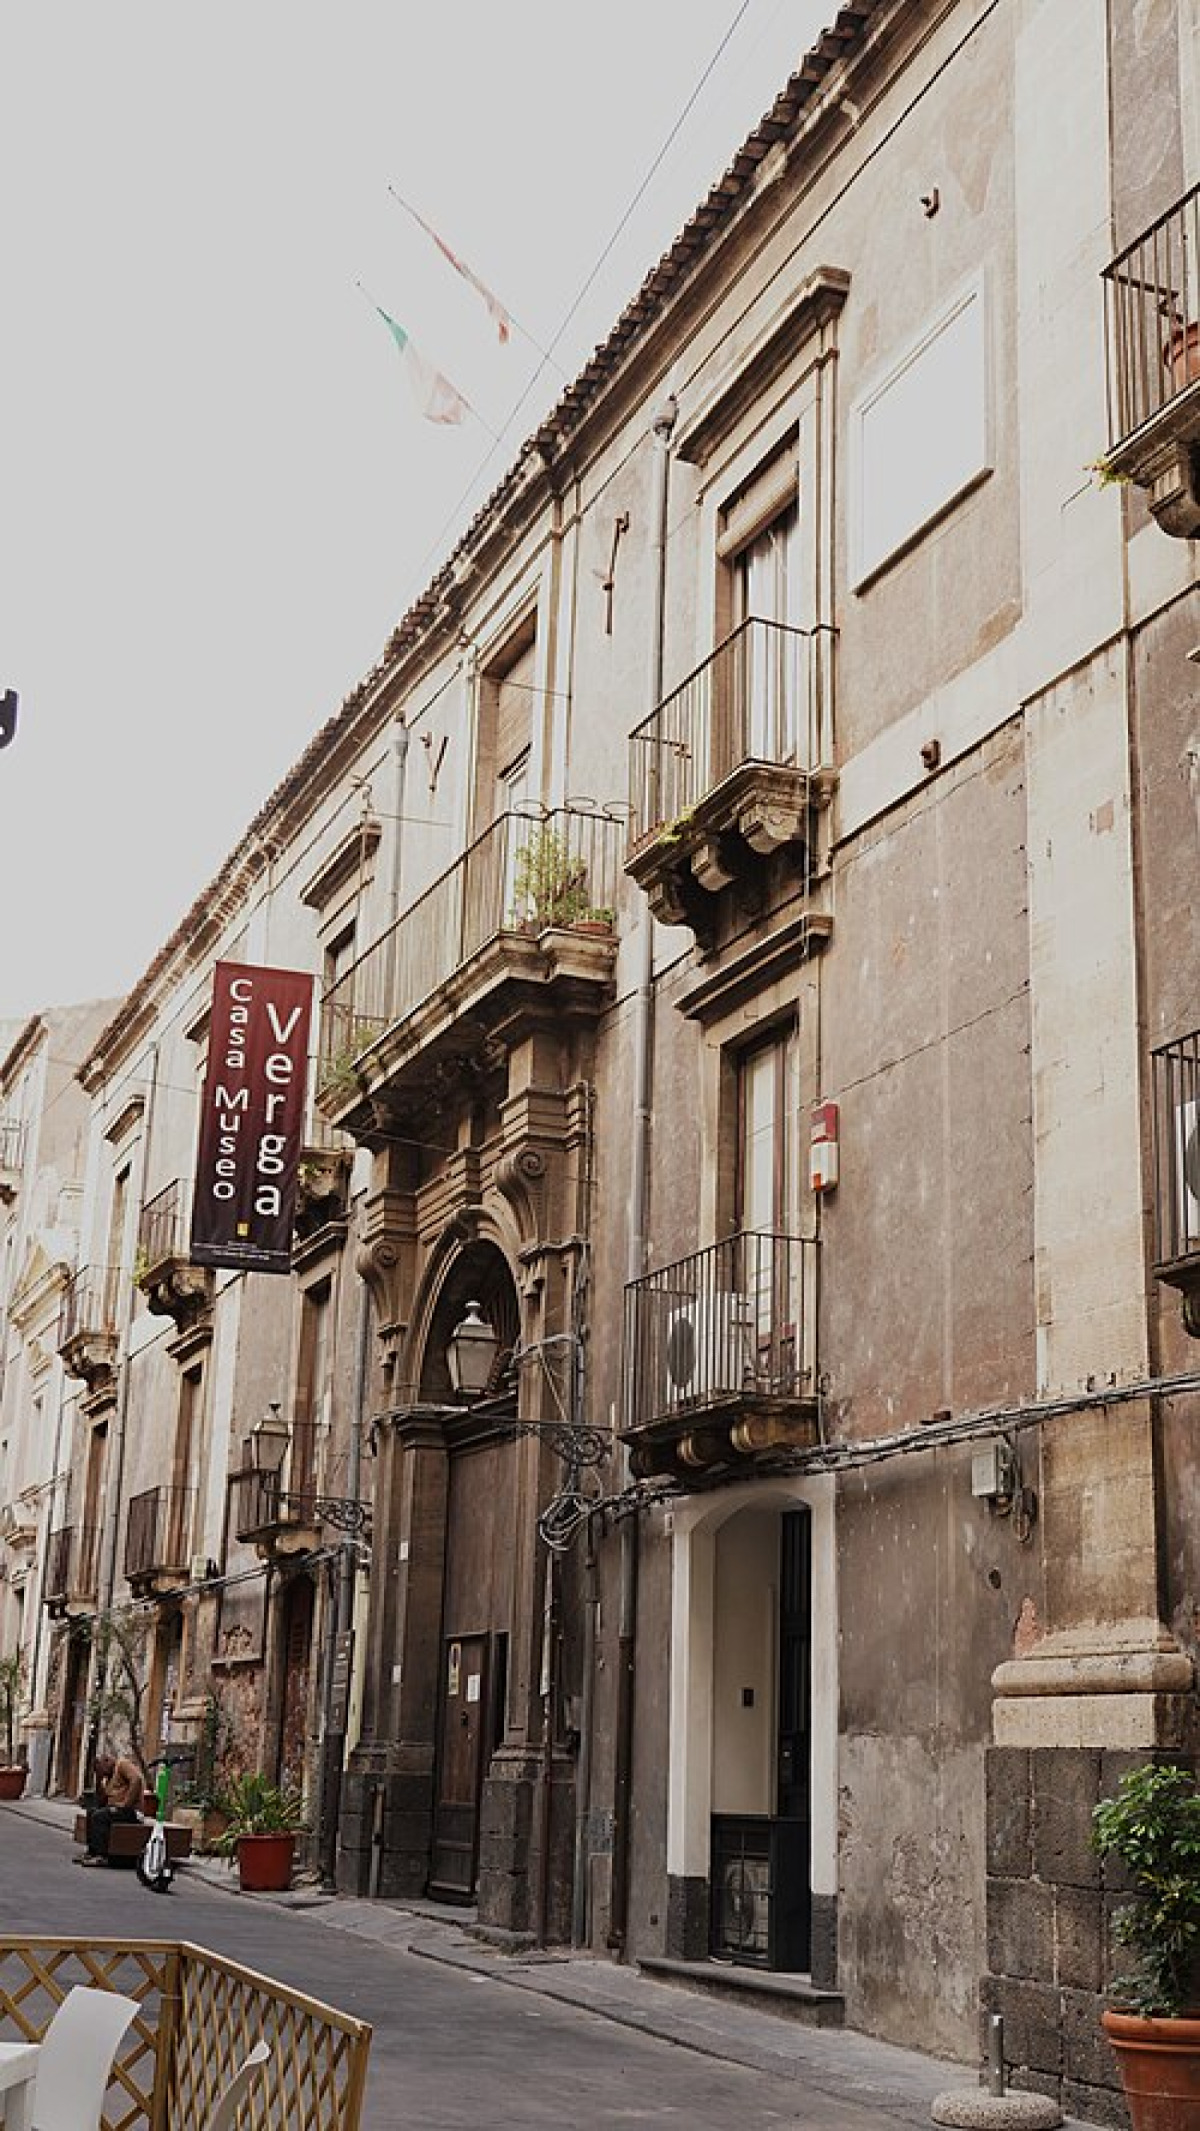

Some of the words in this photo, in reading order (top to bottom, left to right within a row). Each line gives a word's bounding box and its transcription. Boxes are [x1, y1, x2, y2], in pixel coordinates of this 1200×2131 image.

[225, 978, 253, 1069] Casa
[213, 1085, 249, 1200] Museo
[254, 1002, 303, 1217] Verga
